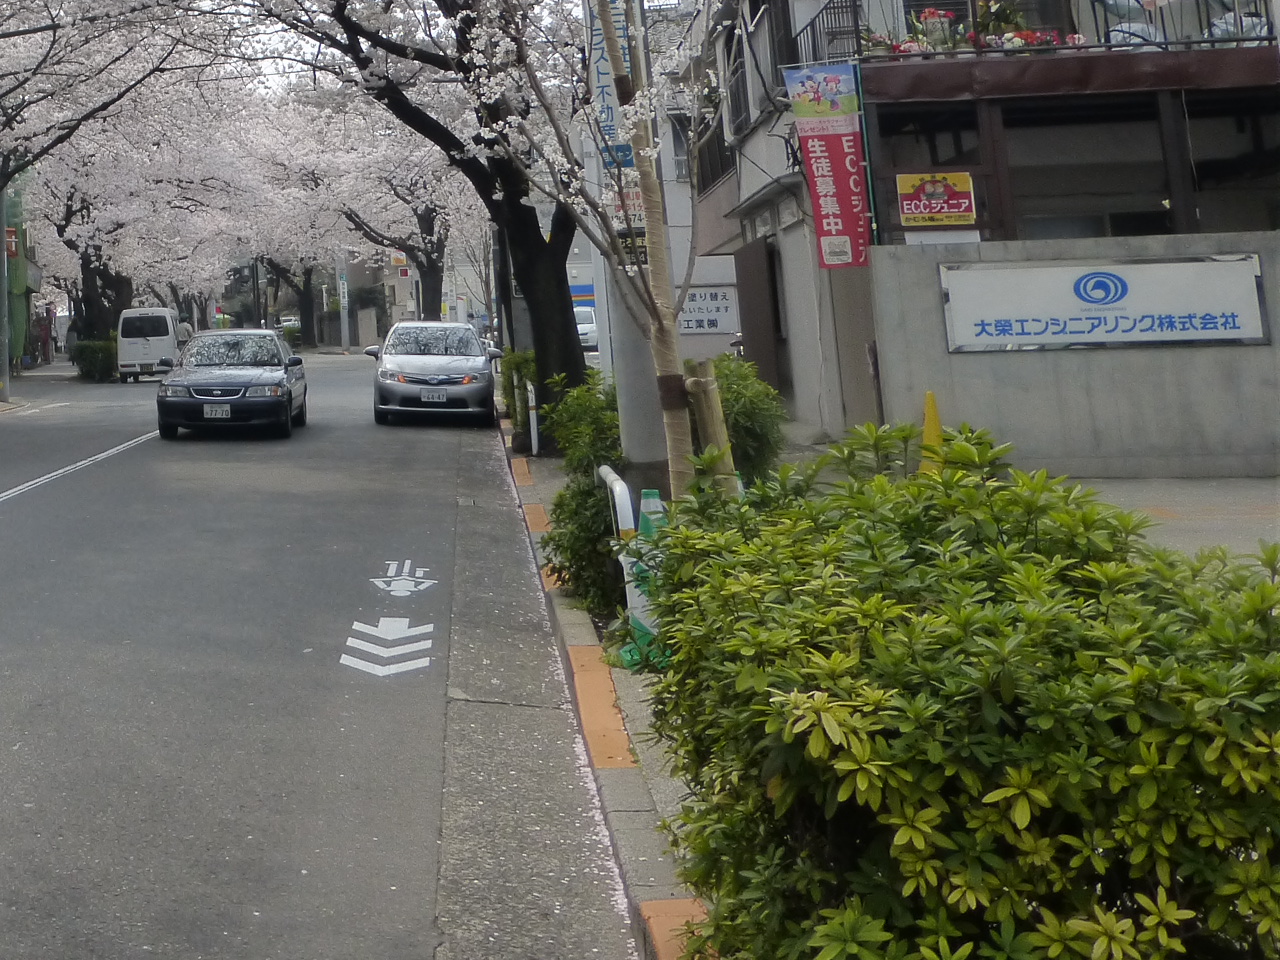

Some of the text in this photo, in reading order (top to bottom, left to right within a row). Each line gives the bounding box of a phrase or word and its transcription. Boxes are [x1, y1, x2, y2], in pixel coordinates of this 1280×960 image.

[807, 138, 843, 235] 生徒募集中
[903, 199, 970, 214] ECCジュニア
[687, 291, 730, 303] 塗り替え
